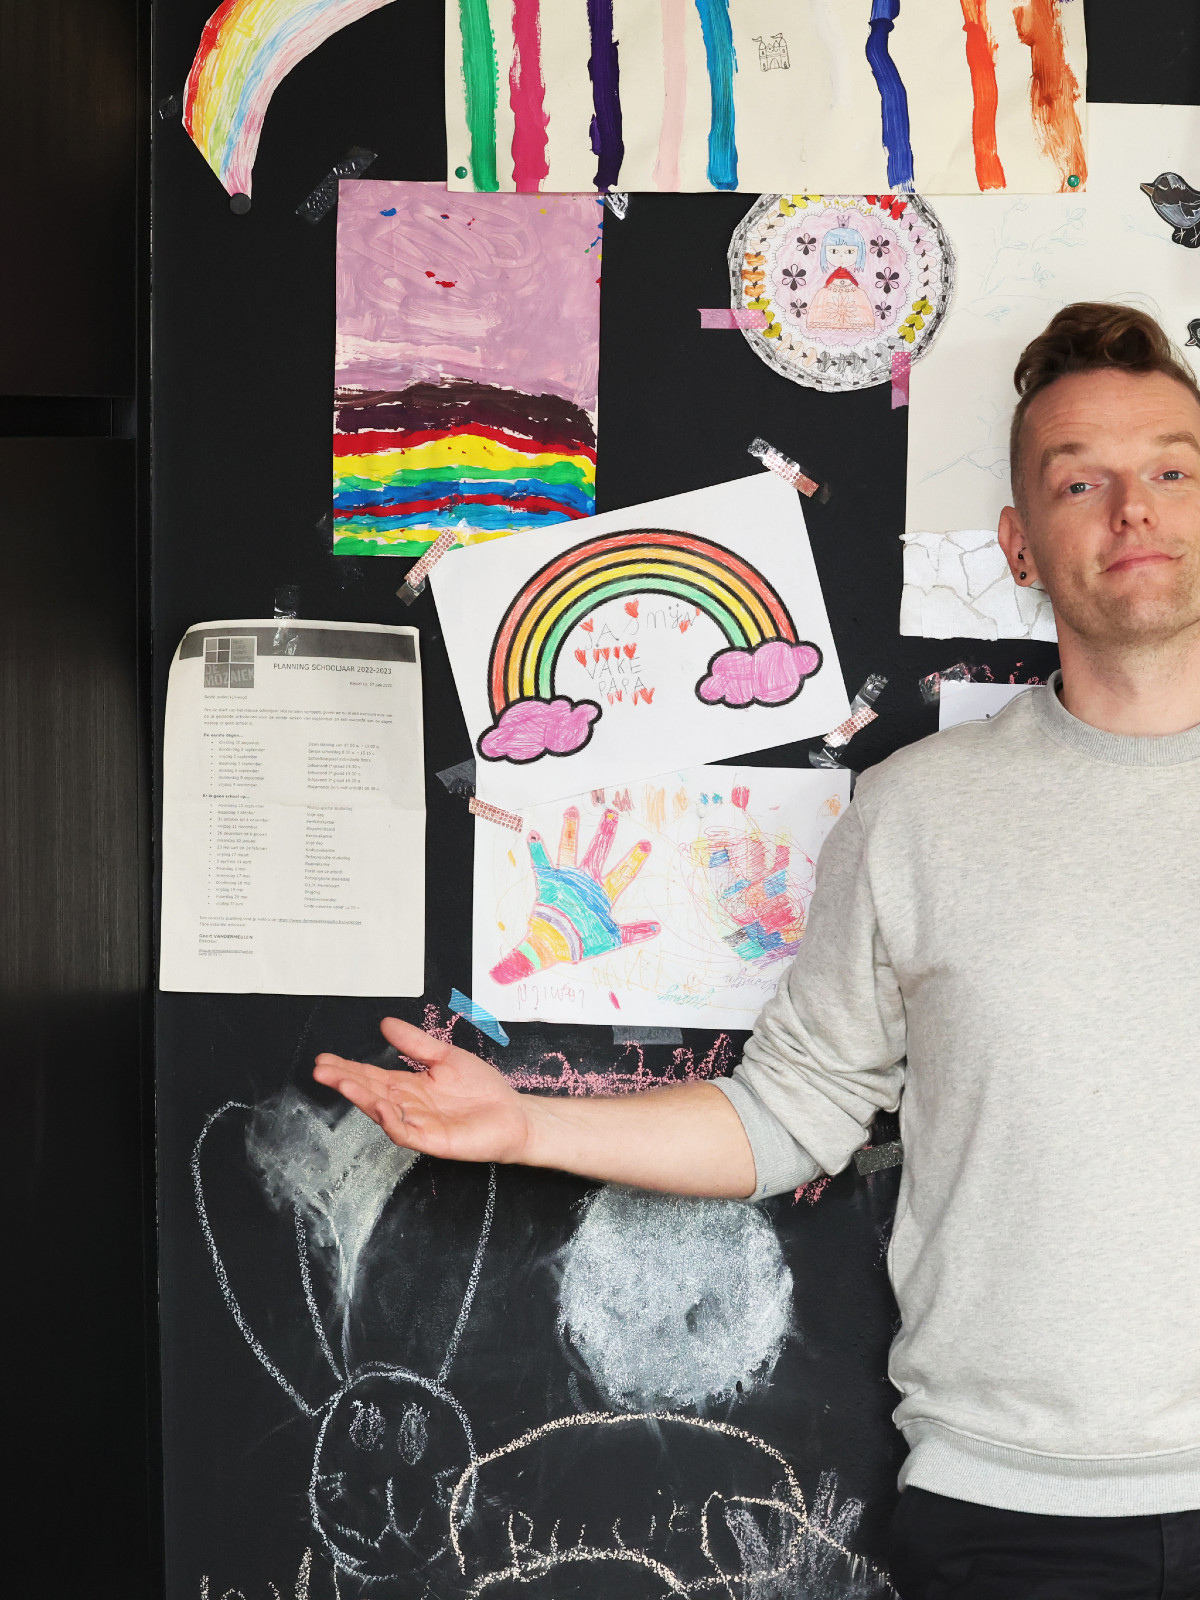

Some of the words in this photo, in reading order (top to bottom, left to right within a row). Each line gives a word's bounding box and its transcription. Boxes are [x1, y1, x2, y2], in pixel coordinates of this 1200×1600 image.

[273, 662, 309, 671] PLANNING
[311, 664, 355, 673] SCHOOLJAAR
[357, 666, 393, 675] 2022-2023
[583, 652, 642, 680] VAKE
[598, 677, 650, 699] PAPA
